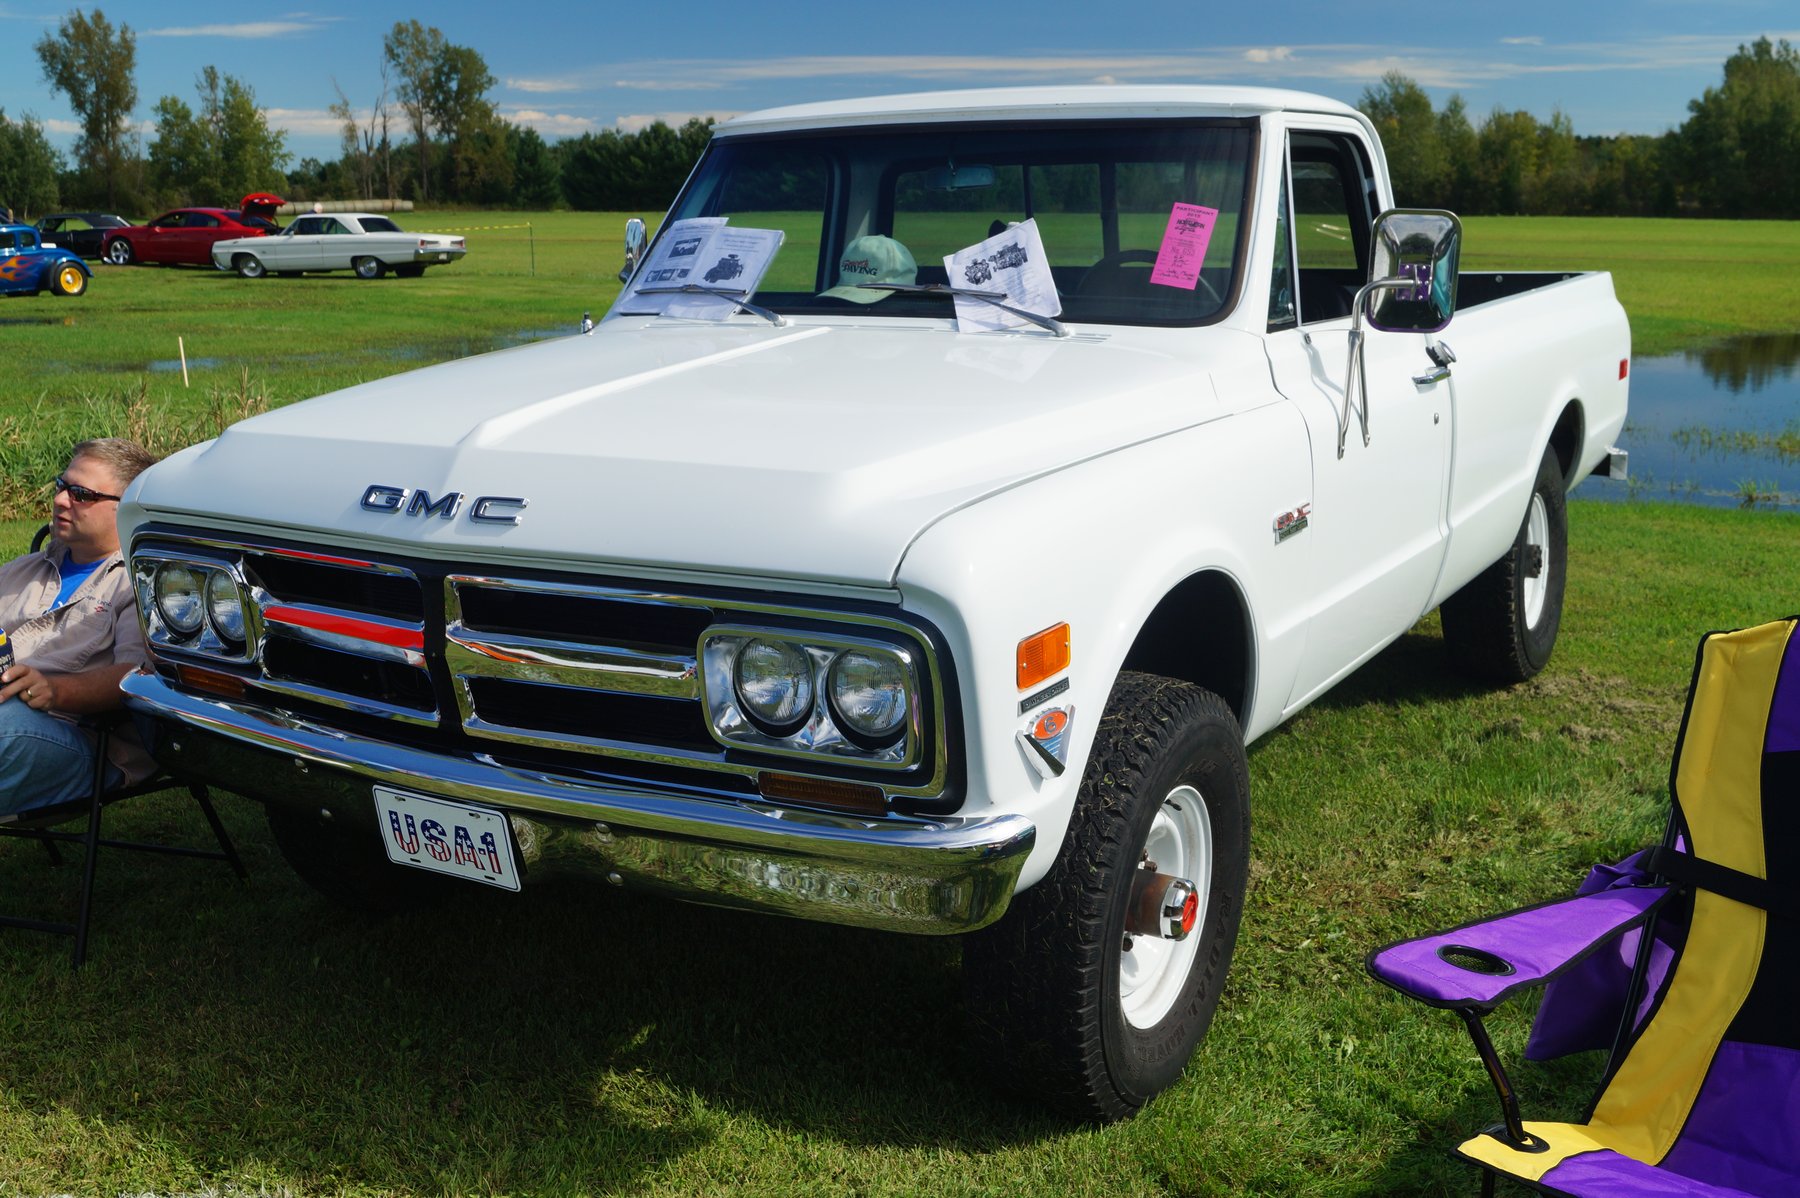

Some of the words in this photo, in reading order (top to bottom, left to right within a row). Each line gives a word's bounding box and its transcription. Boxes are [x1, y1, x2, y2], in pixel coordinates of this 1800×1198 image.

[1176, 206, 1214, 216] PARTICIPANT
[841, 264, 878, 276] PAVING
[359, 484, 531, 527] GMC
[1187, 891, 1233, 1017] RADIAL
